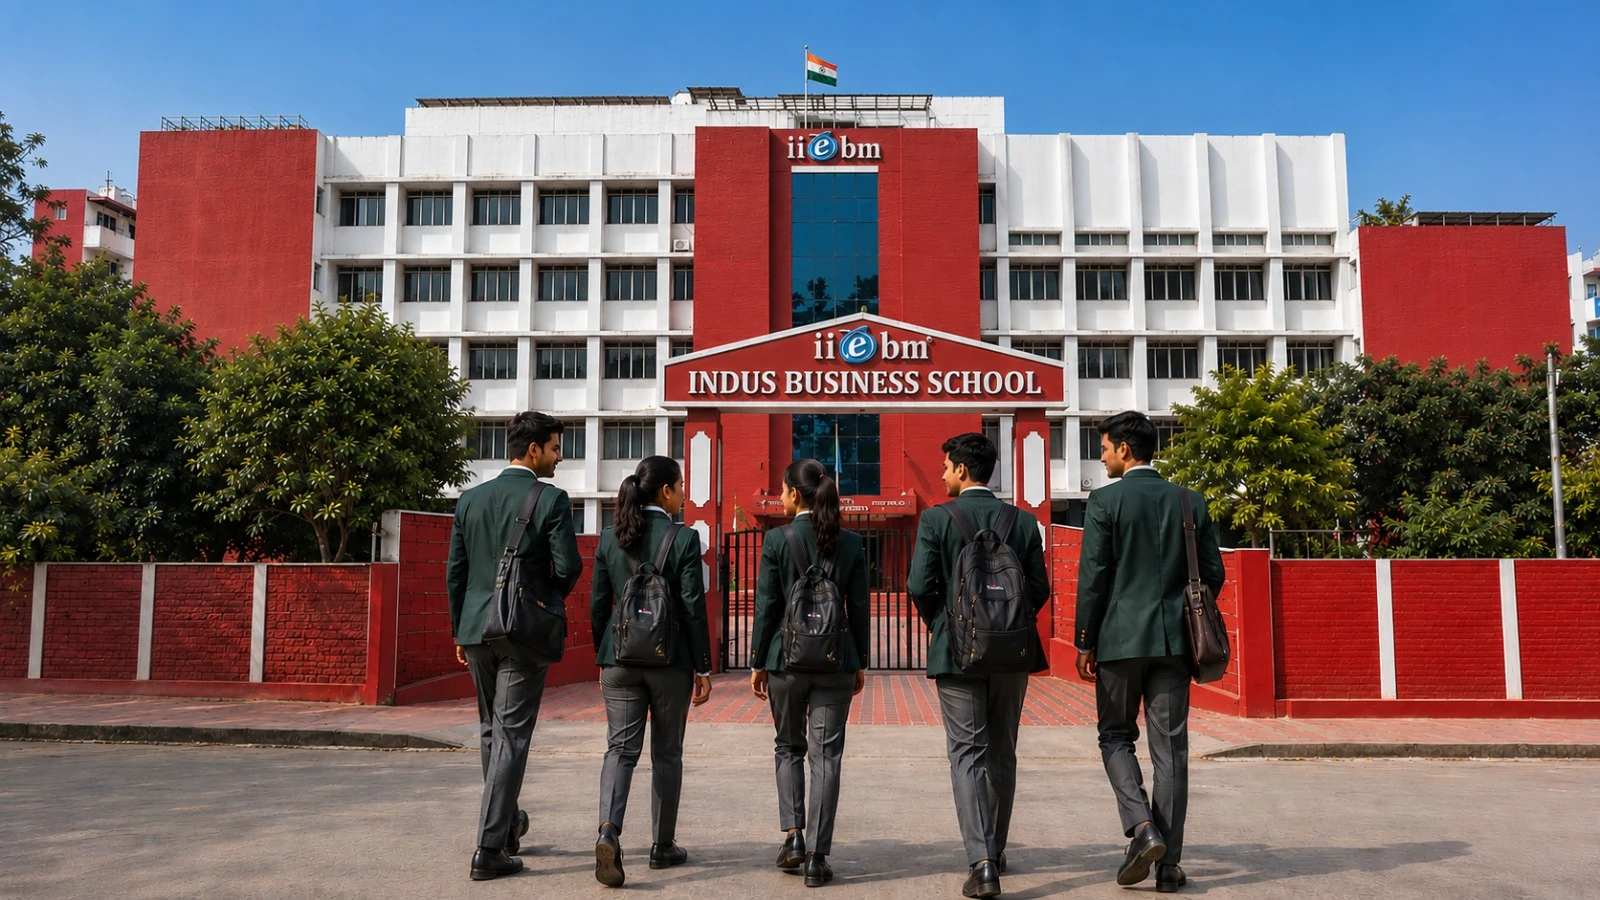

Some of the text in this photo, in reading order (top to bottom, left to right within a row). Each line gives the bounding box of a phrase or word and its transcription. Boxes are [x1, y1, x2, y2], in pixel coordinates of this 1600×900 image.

[787, 132, 881, 160] iiebm
[688, 371, 1041, 394] INDUS BUSINESS SCHOOL
